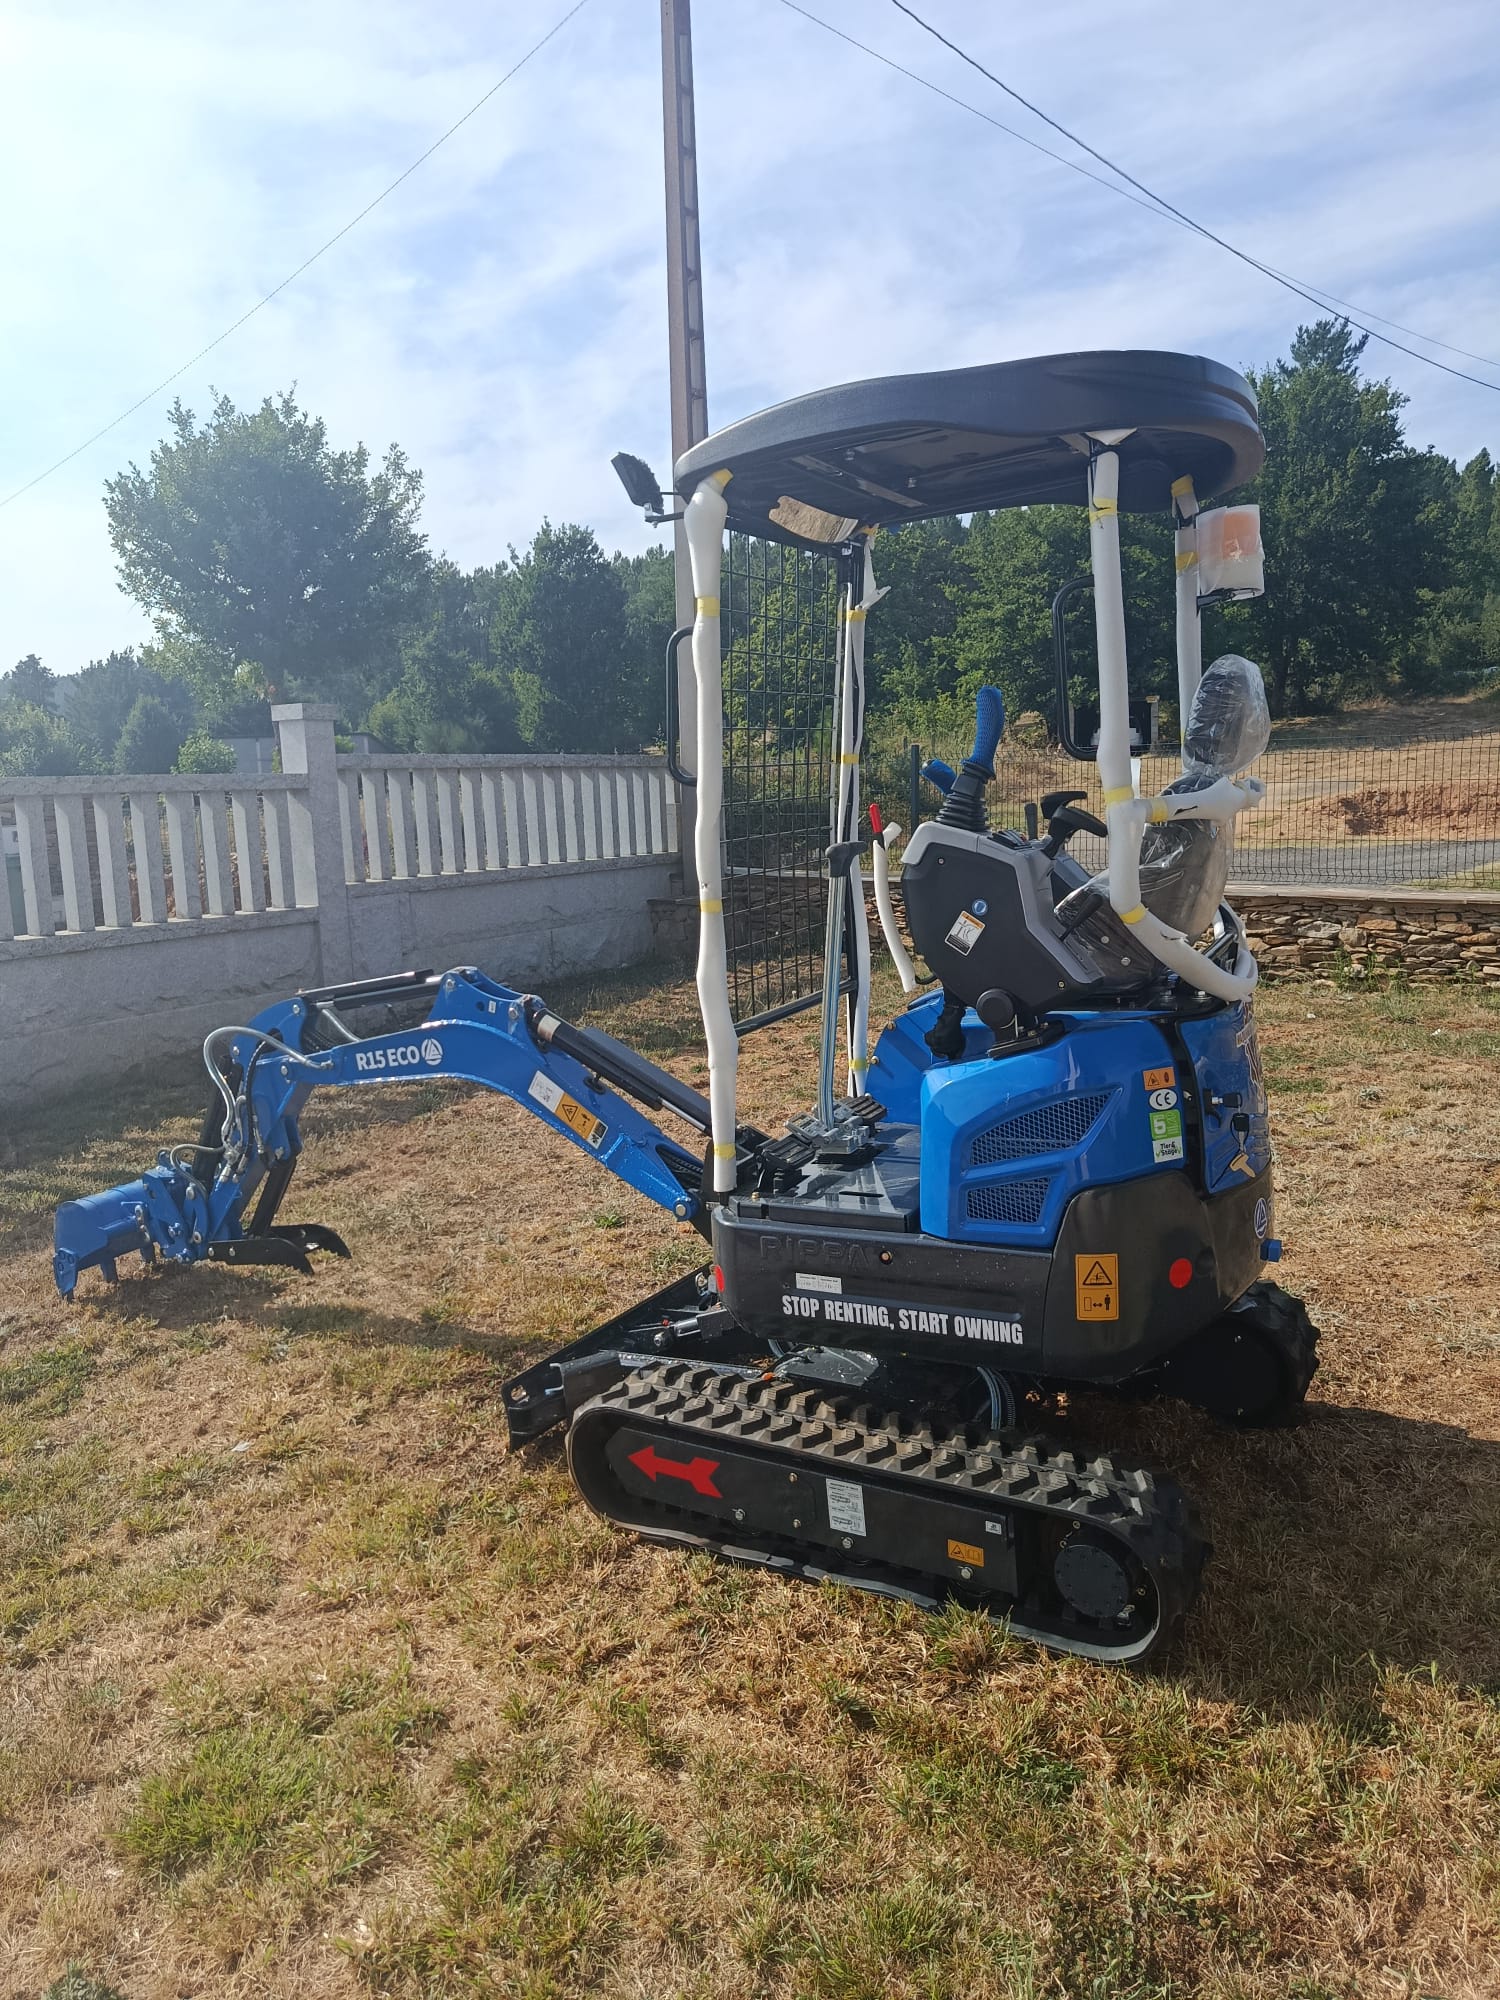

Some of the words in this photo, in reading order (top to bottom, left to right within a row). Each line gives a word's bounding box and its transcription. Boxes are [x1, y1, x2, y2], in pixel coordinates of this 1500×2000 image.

[355, 1050, 386, 1071] R15
[387, 1045, 420, 1067] ECO
[1156, 1092, 1171, 1106] CE
[782, 1295, 820, 1318] STOP
[823, 1299, 895, 1330] RENTING,
[898, 1308, 949, 1335] START
[953, 1315, 1024, 1345] OWNING
